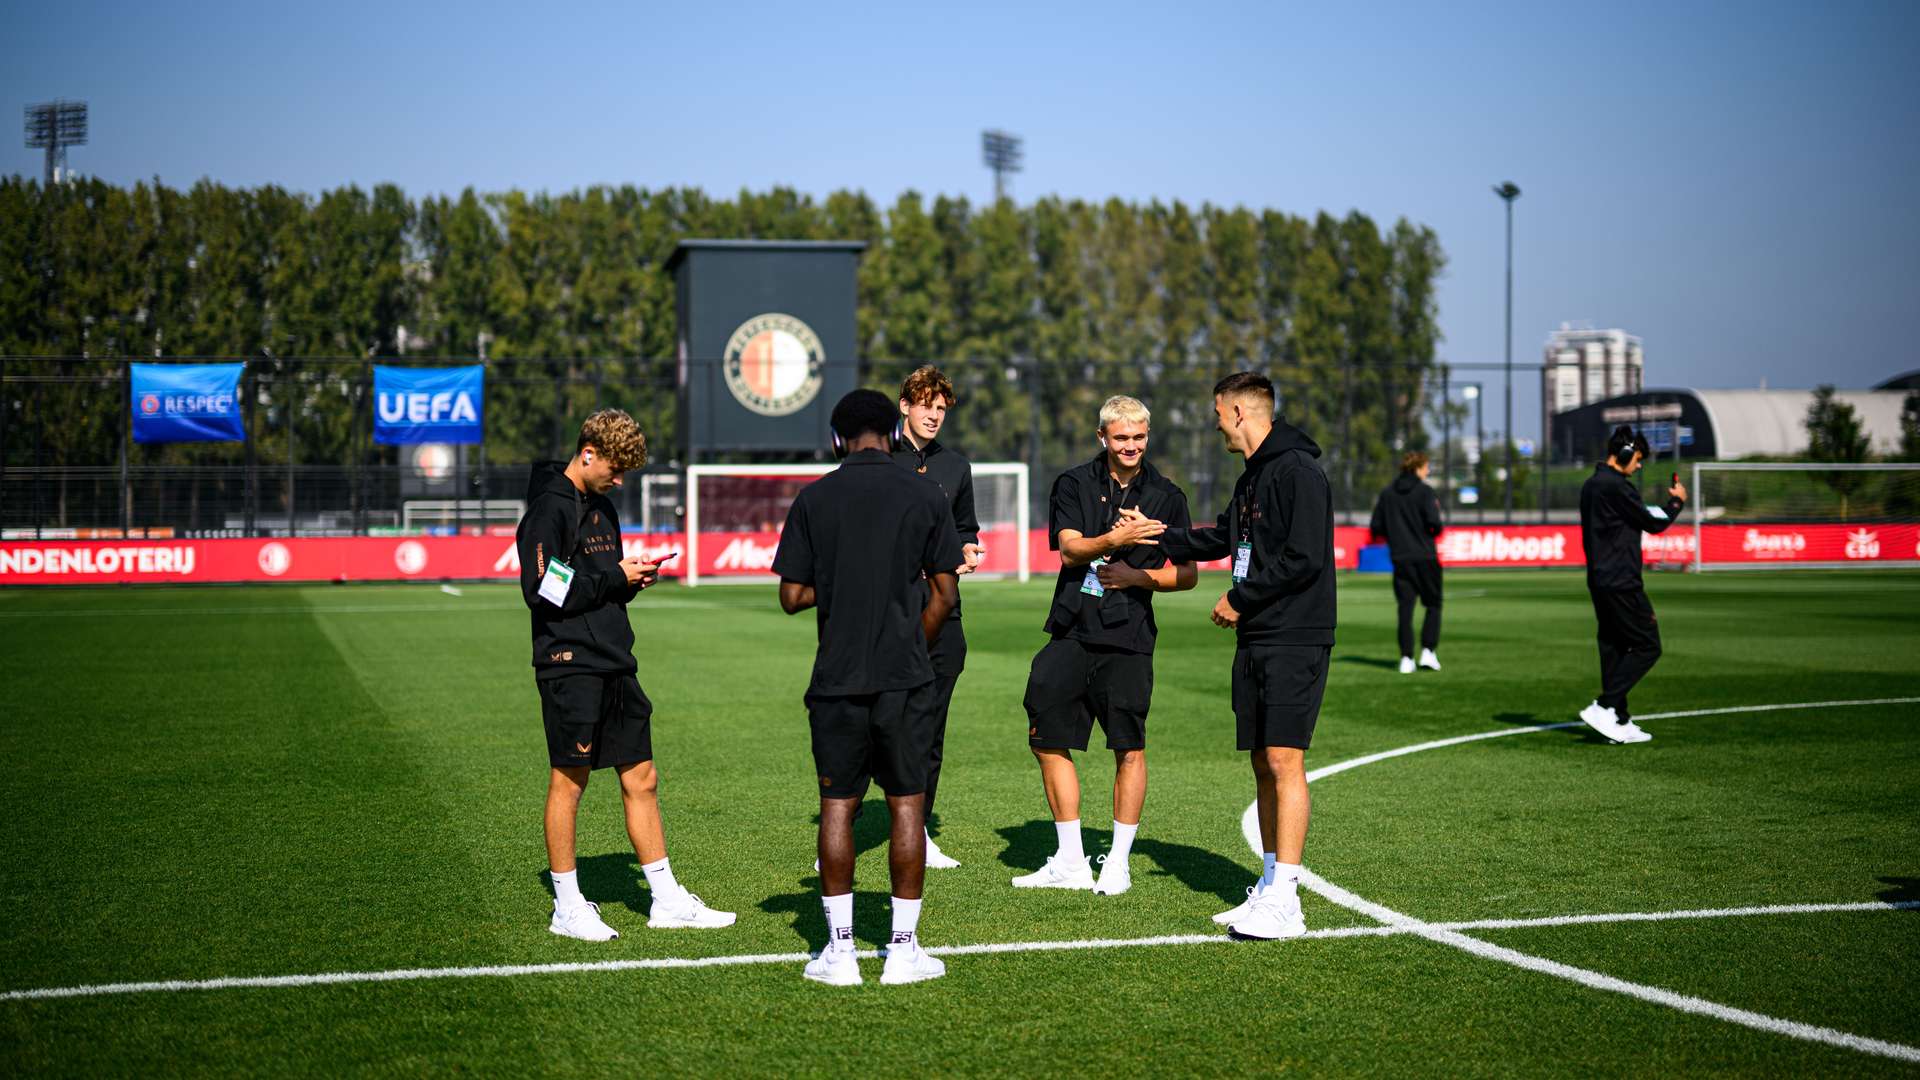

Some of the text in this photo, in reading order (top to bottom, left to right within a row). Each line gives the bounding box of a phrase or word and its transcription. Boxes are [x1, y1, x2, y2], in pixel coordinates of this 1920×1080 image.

[164, 394, 234, 413] RESPECT
[378, 391, 478, 423] UEFA
[892, 931, 911, 943] FS
